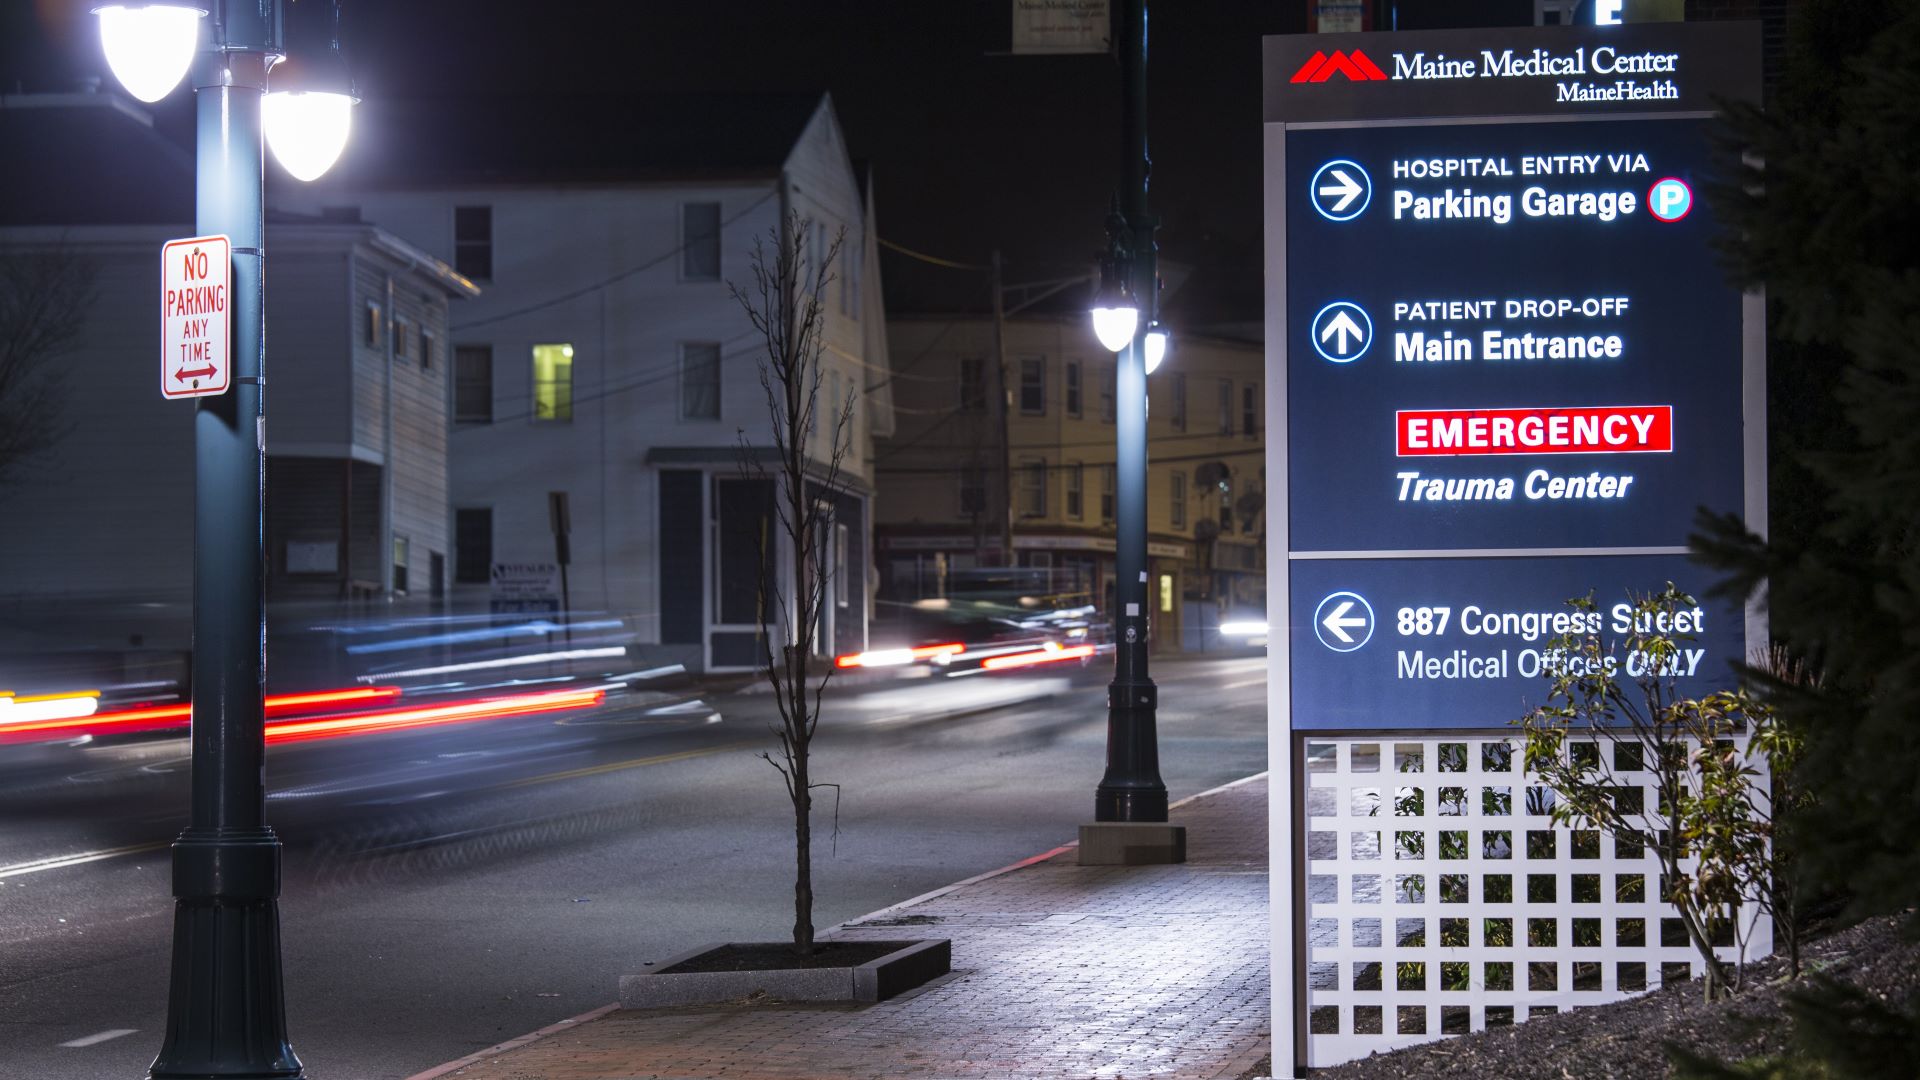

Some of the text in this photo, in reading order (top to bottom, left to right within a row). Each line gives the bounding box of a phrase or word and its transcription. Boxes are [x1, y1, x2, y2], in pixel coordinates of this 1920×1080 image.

[1392, 47, 1678, 80] Maine Medical Center
[1556, 80, 1679, 102] MaineHealth
[1393, 153, 1650, 179] HOSPITAL ENTRY VIA
[1394, 184, 1686, 224] Parking Garage P
[184, 252, 208, 281] NO
[167, 285, 224, 317] PARKING
[1394, 298, 1629, 321] PATIENT DROP-OFF
[183, 318, 209, 339] ANY
[180, 341, 211, 362] TIME
[1395, 330, 1623, 362] Main Entrance
[1407, 414, 1655, 449] EMERGENCY
[1396, 469, 1634, 501] Trauma Center
[1397, 603, 1704, 642] 887 Congress Street
[1397, 649, 1508, 679] Medical
[1517, 648, 1617, 679] Offices
